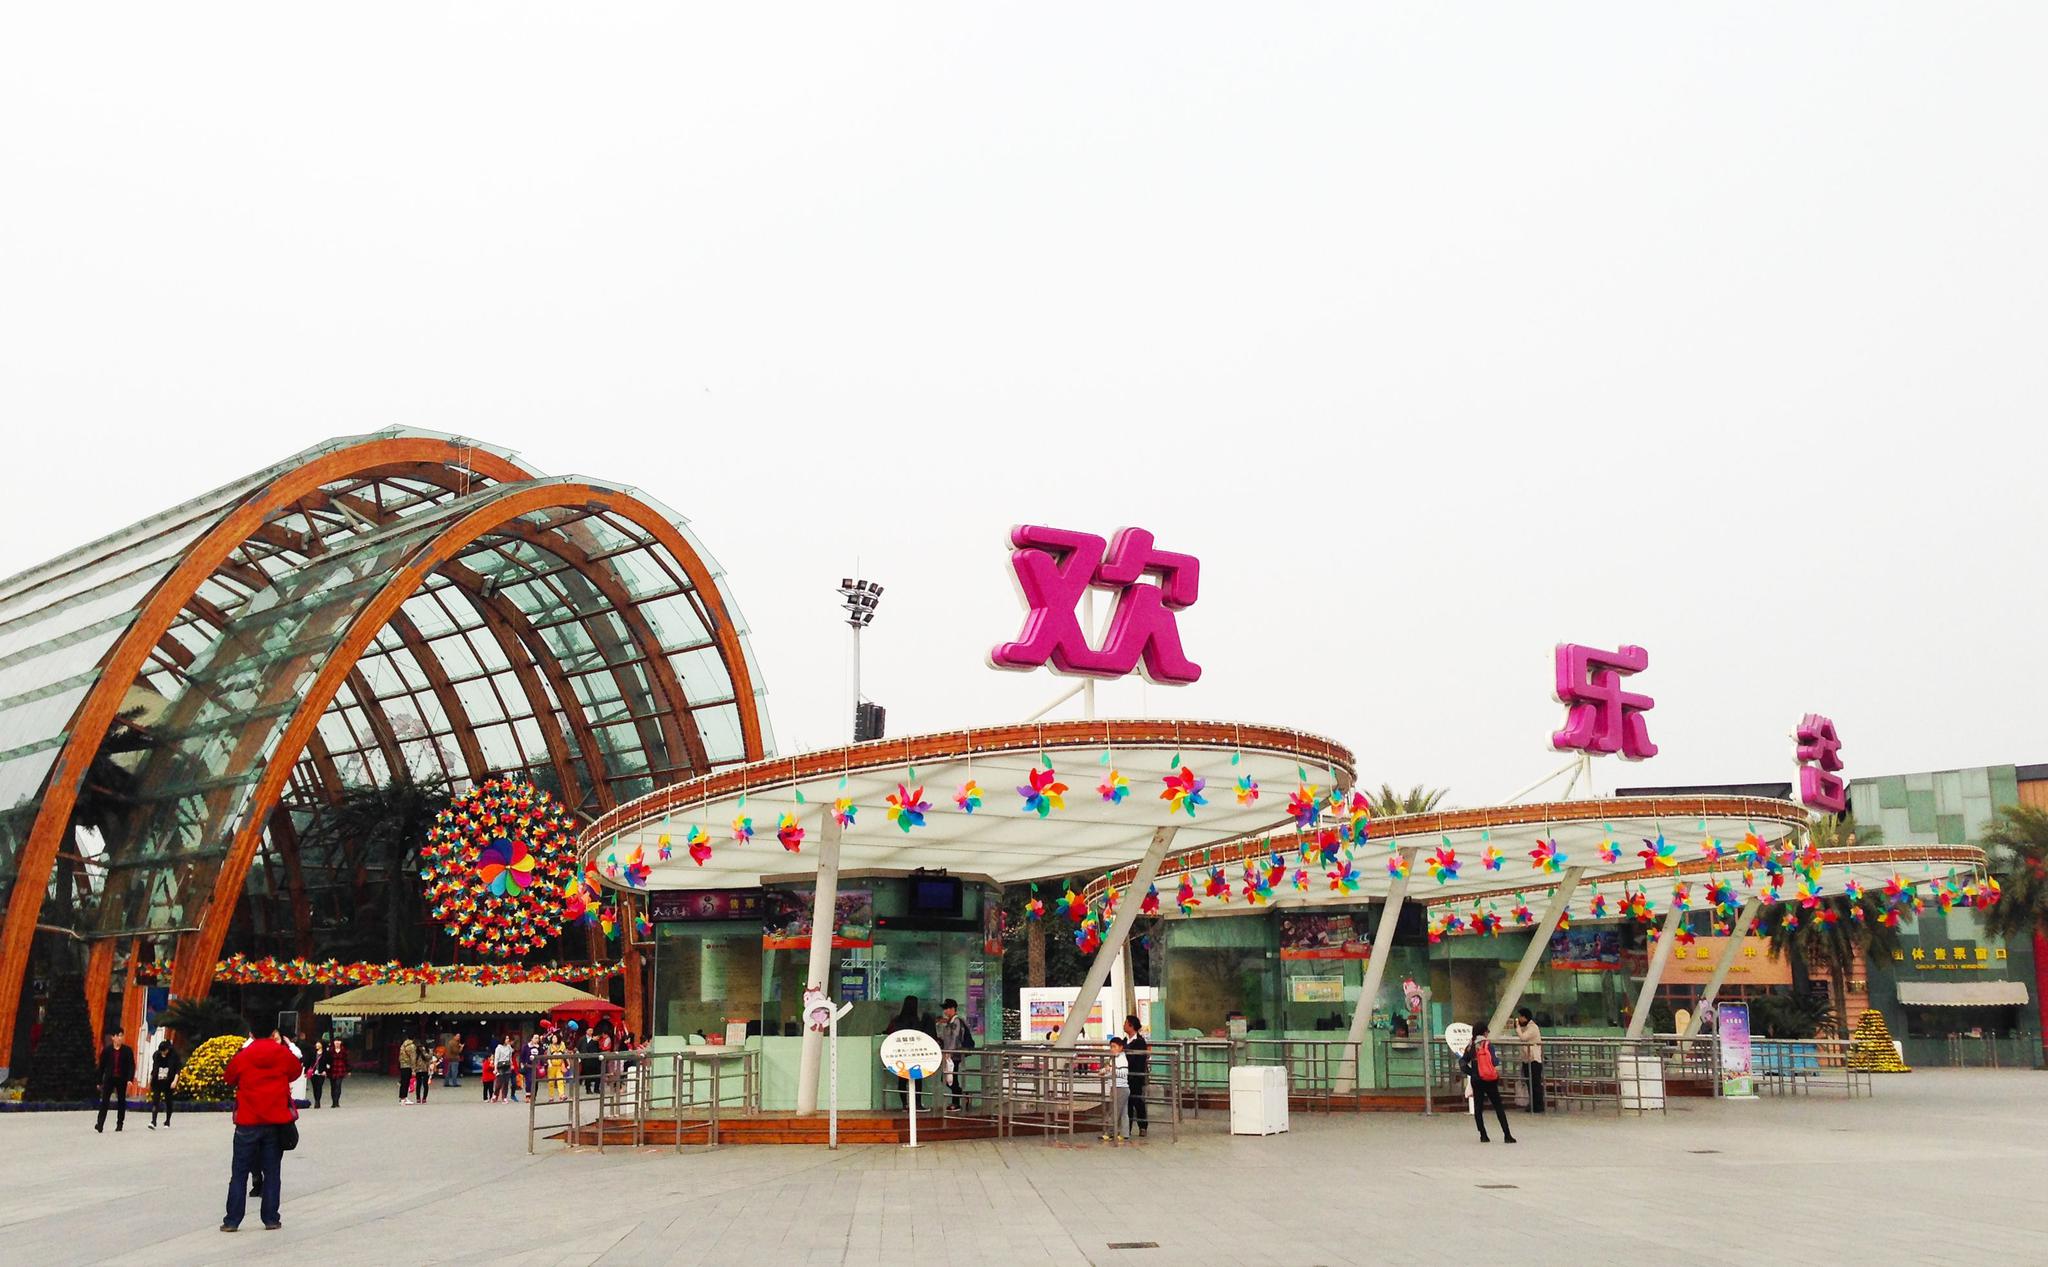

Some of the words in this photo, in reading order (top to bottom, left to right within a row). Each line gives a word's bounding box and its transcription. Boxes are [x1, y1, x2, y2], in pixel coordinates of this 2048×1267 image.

[988, 524, 1202, 685] 欢
[1552, 643, 1659, 761] 乐
[1795, 712, 1847, 812] 谷
